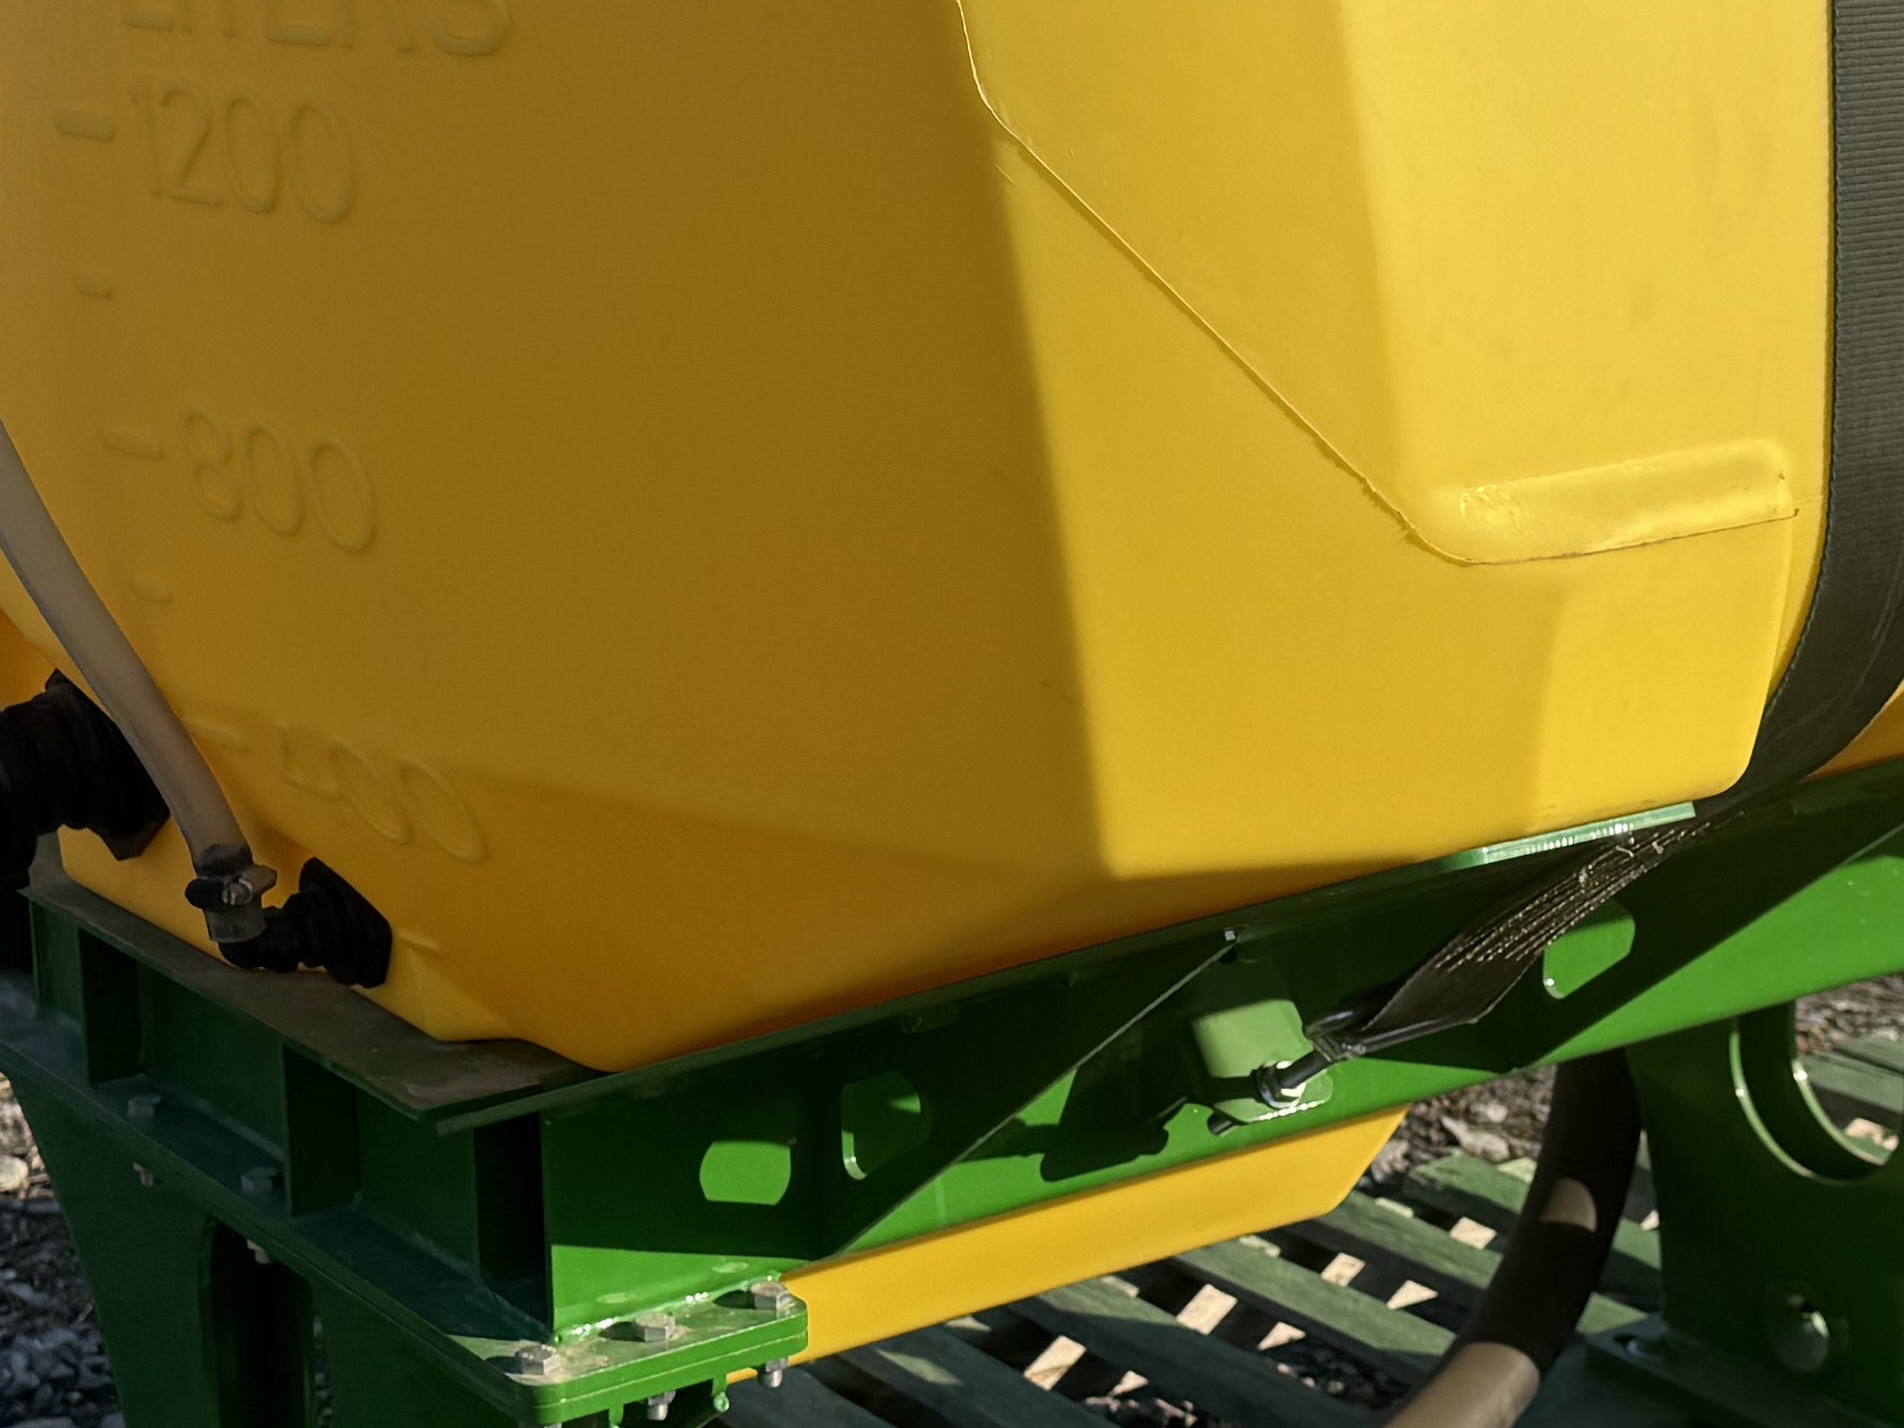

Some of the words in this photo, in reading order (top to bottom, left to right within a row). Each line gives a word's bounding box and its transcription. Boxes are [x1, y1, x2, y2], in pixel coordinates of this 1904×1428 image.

[128, 76, 355, 224] 1200
[181, 410, 376, 554] 800
[273, 713, 490, 864] 400
